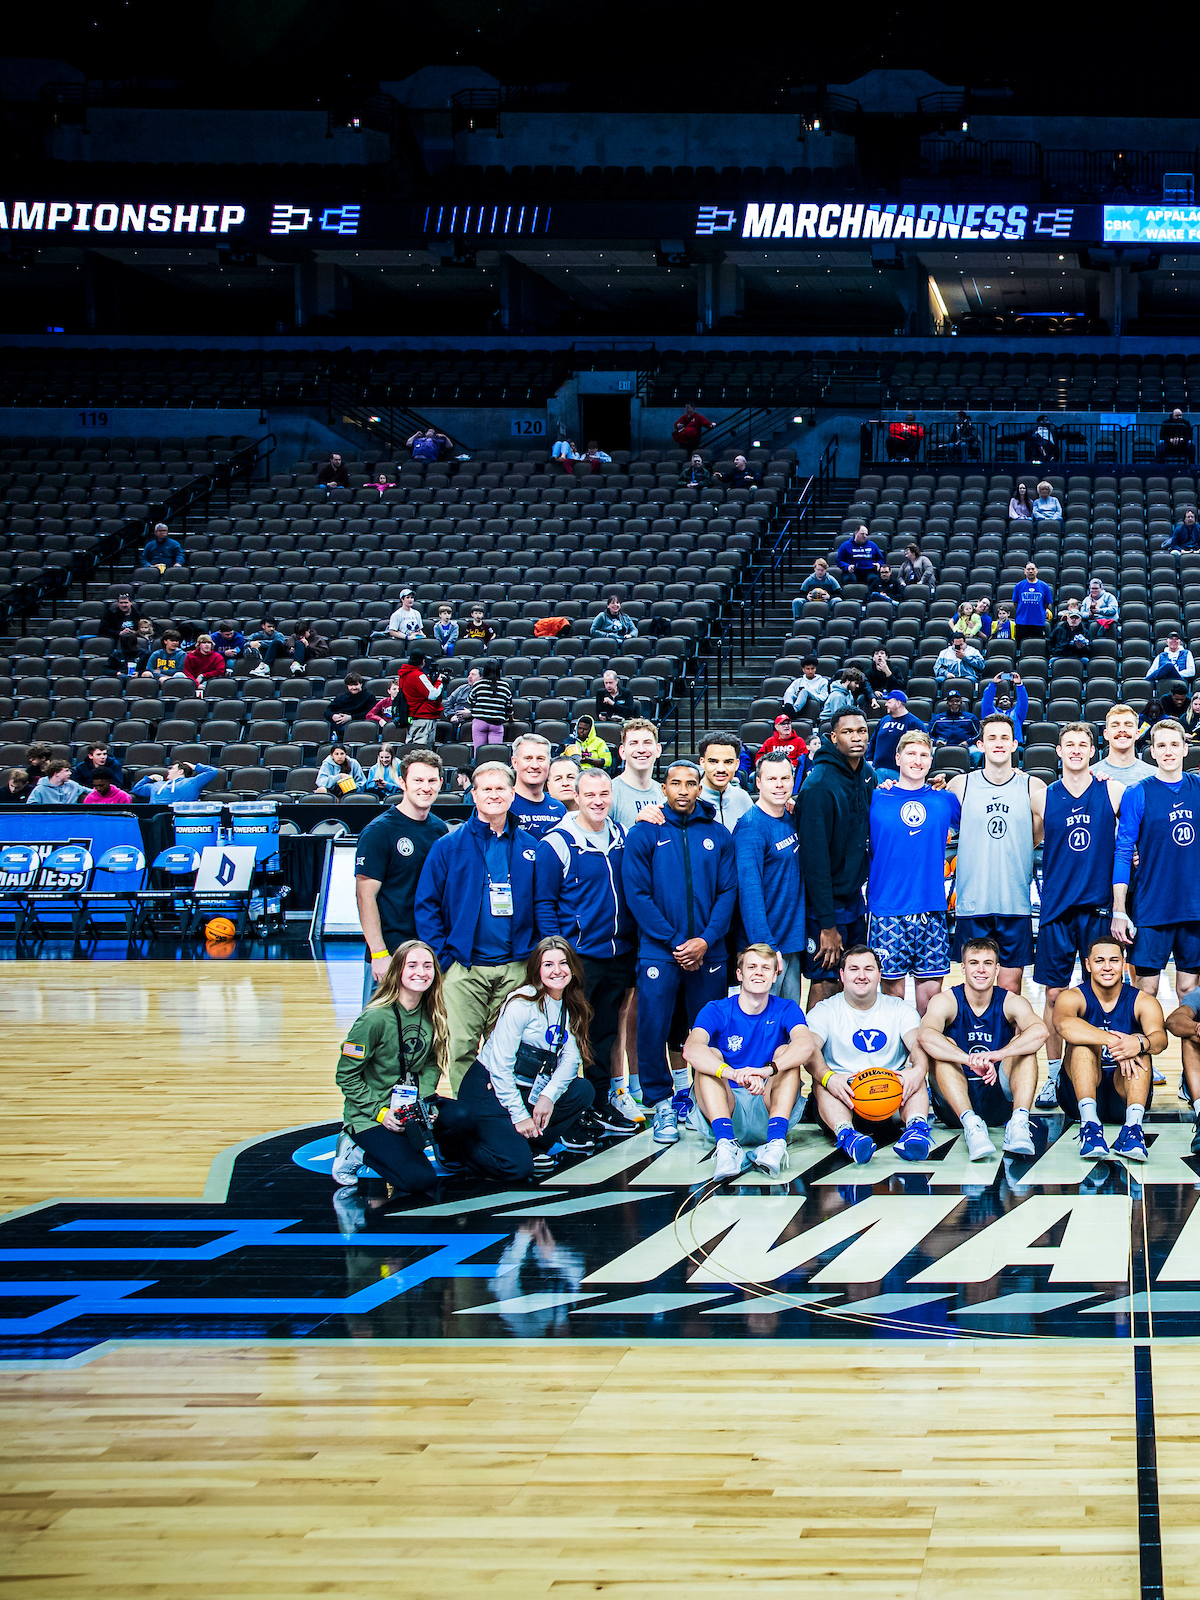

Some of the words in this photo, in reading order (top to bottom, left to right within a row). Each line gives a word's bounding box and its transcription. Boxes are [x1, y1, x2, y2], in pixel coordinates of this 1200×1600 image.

[1104, 219, 1133, 231] CBK
[1146, 228, 1185, 239] WAKE
[78, 412, 108, 426] 119
[514, 420, 543, 434] 120
[882, 721, 906, 731] BYU
[986, 802, 1010, 814] BYU
[1065, 814, 1092, 828] BYU
[1168, 809, 1194, 823] BYU
[991, 819, 1004, 835] 24
[1073, 831, 1086, 847] 21
[1177, 828, 1191, 845] 20
[967, 1032, 993, 1043] BYU
[857, 1069, 894, 1081] Wilson
